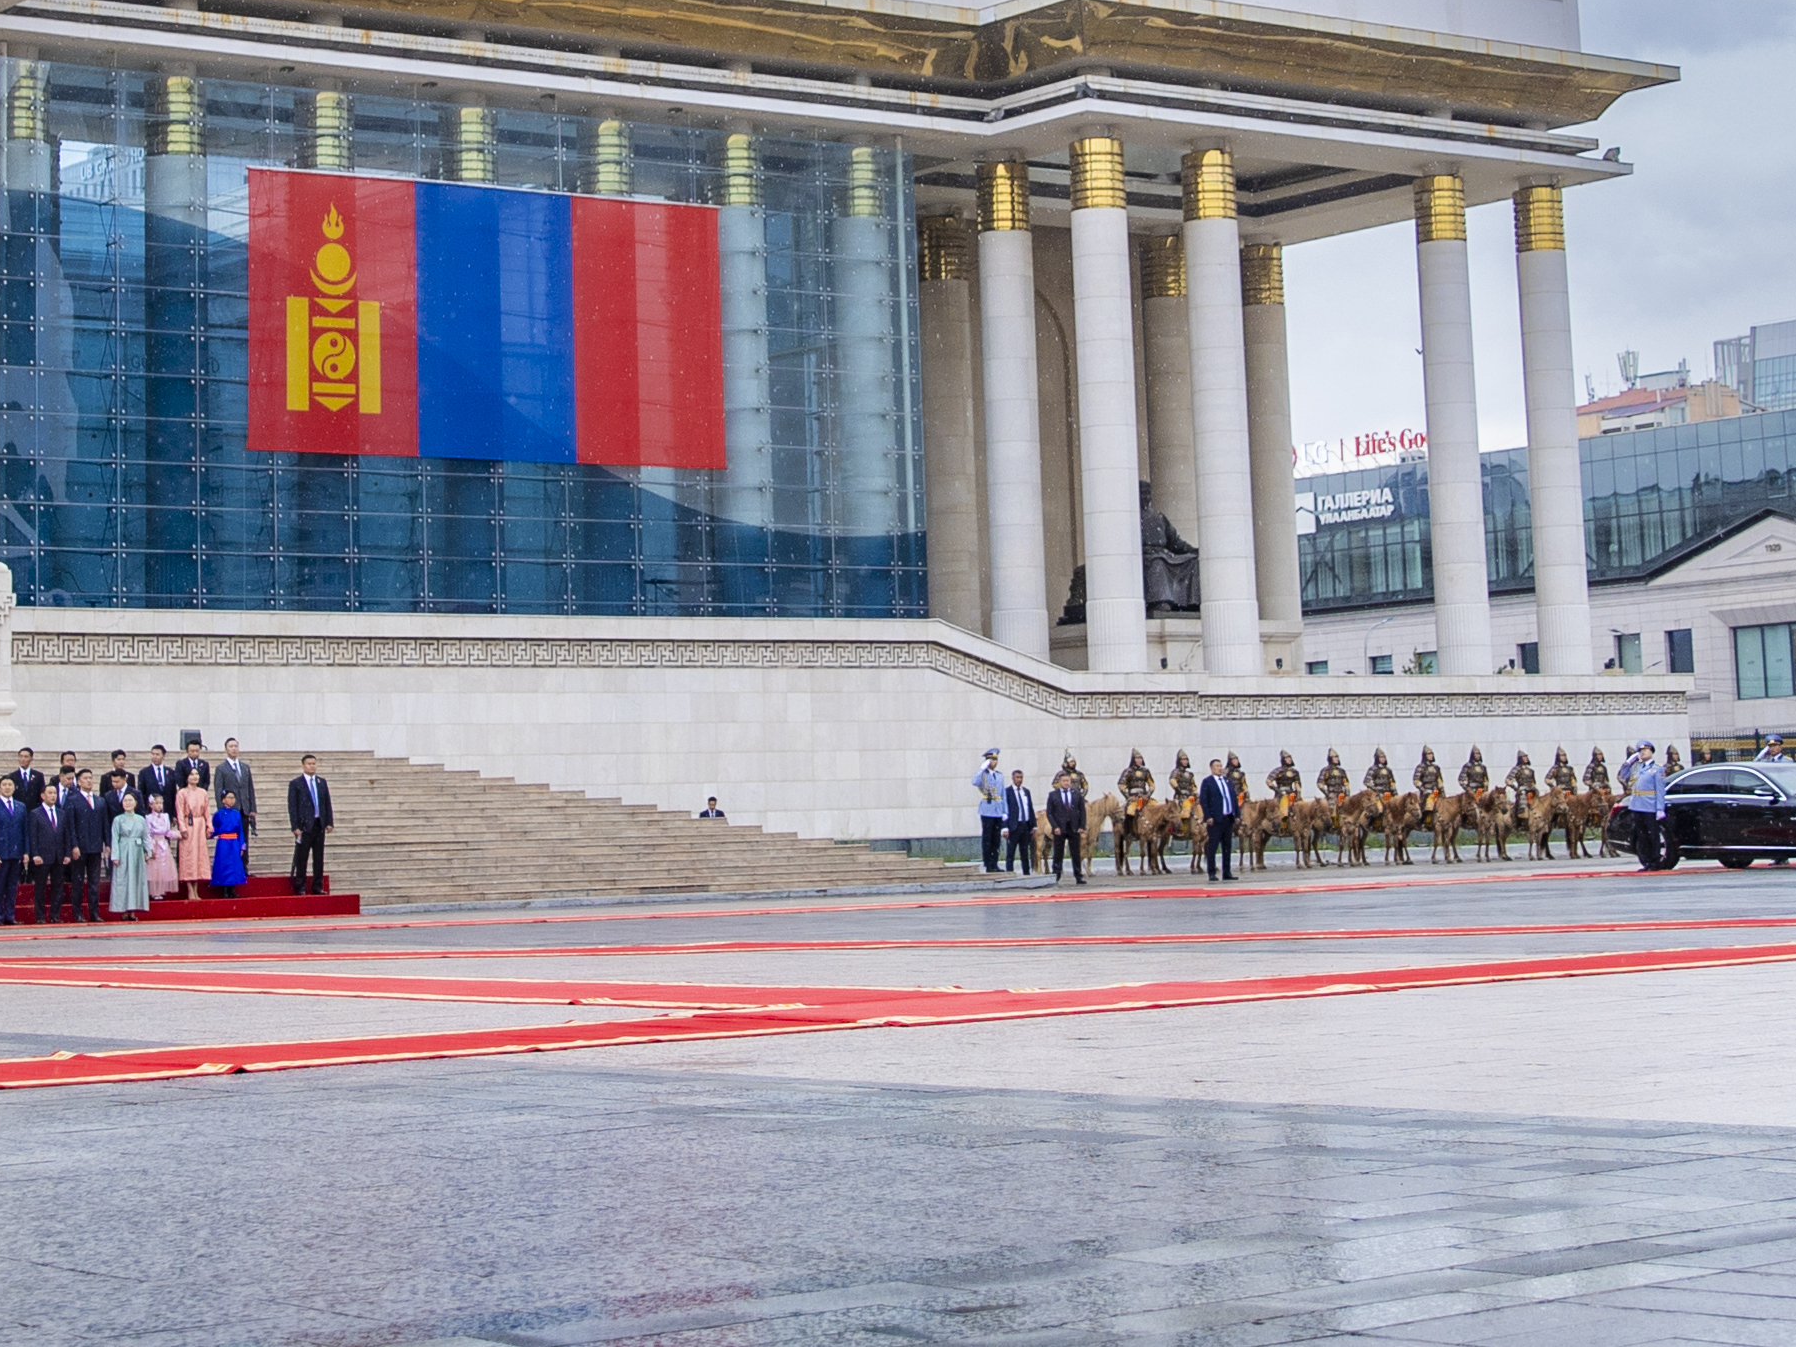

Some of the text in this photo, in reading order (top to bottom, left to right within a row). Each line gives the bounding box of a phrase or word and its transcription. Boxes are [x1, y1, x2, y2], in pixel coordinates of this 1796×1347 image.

[80, 162, 94, 181] UB
[1300, 440, 1329, 466] LG
[1354, 430, 1397, 457] Life's
[1317, 487, 1394, 512] ГАЛЛЕРИА
[1318, 505, 1395, 525] УЛААНБААТАР
